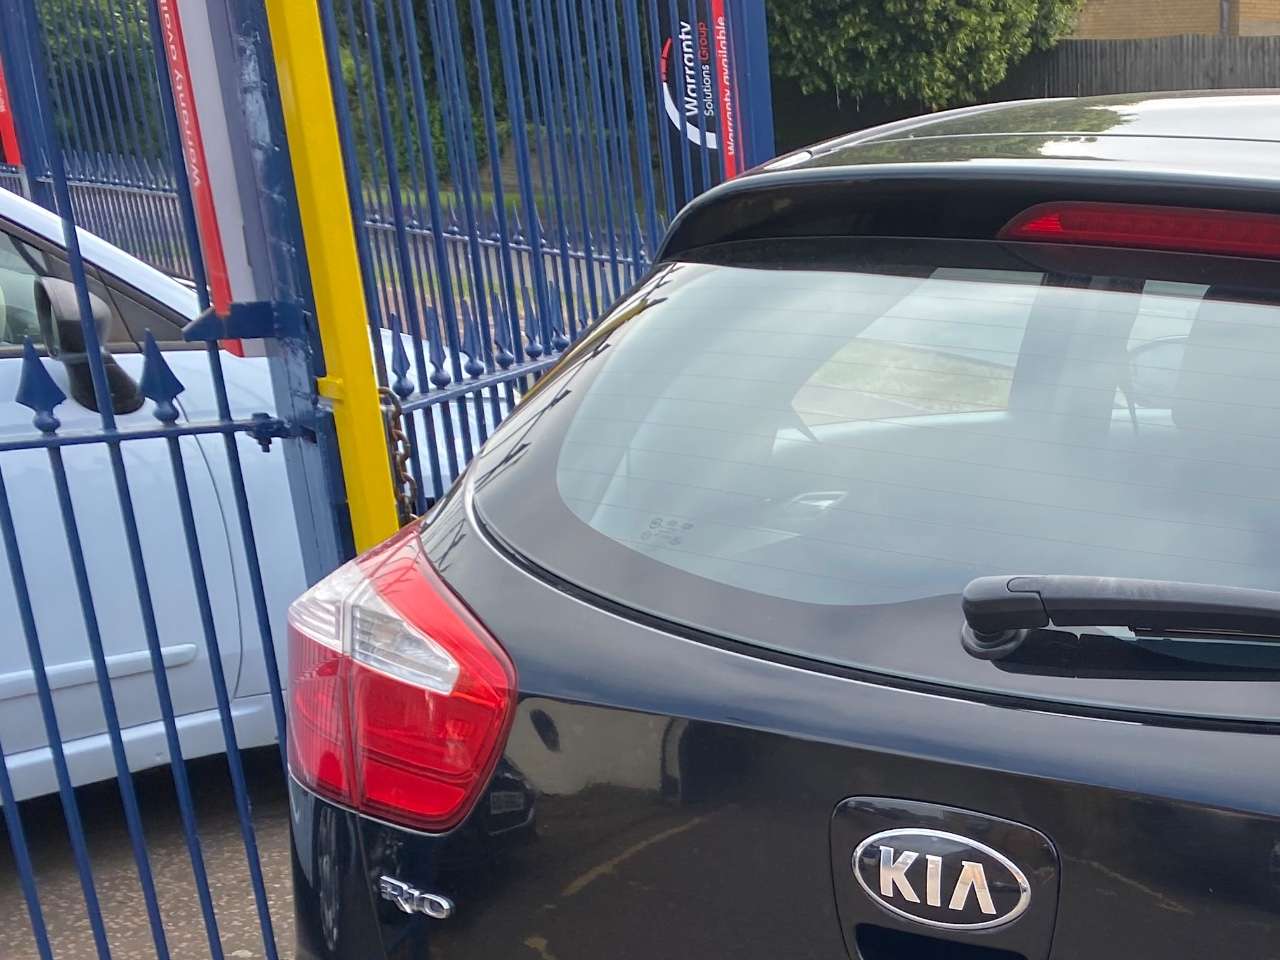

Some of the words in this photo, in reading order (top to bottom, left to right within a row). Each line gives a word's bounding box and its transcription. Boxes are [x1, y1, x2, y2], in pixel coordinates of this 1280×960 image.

[698, 22, 710, 61] Group
[702, 64, 714, 117] Solutions
[174, 68, 201, 188] Warranty
[879, 845, 997, 915] KIA
